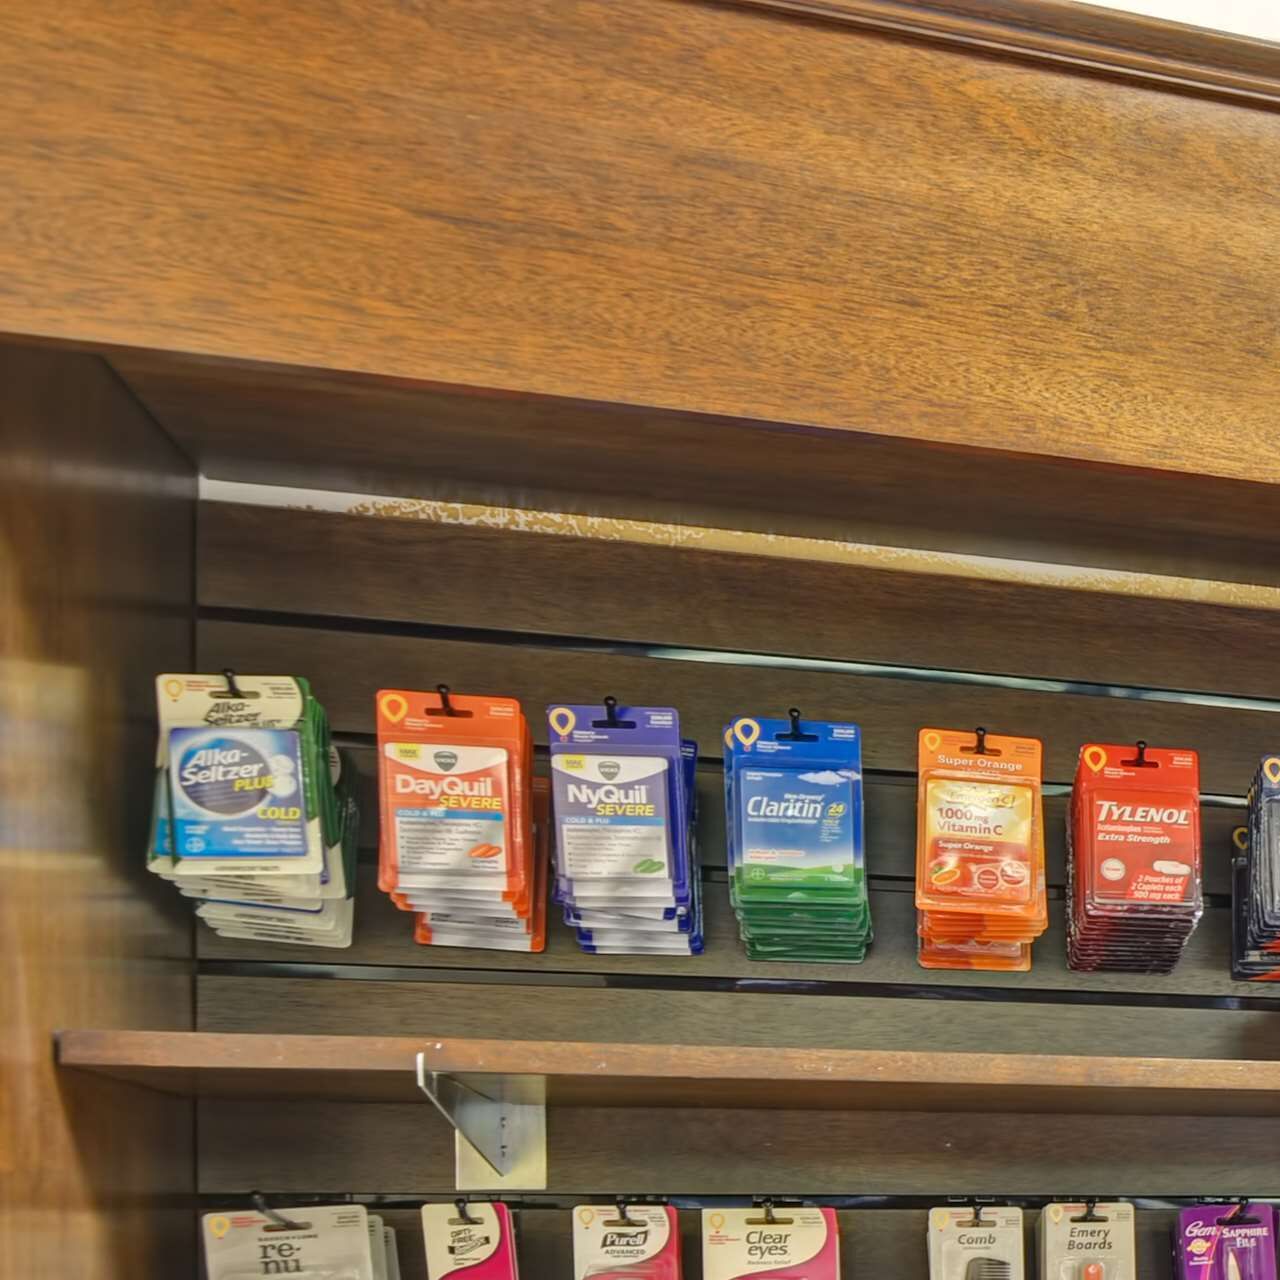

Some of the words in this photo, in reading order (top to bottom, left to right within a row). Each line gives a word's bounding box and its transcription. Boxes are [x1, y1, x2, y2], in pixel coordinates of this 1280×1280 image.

[186, 748, 249, 767] Alka-
[937, 754, 974, 768] Super
[977, 758, 1023, 772] Orange
[181, 762, 264, 786] Seltzer
[233, 775, 274, 792] PLUS
[395, 774, 492, 799] DayQuil
[439, 795, 503, 809] SEVERE
[567, 783, 648, 808] NyQuil
[256, 806, 300, 821] COLD
[596, 804, 655, 817] SEVERE
[747, 796, 822, 818] Claritin
[937, 807, 974, 823] 1000
[1096, 800, 1191, 825] TYLENOL
[937, 820, 992, 836] Vitamin
[993, 824, 1004, 837] C
[1097, 832, 1125, 843] Extra
[1126, 834, 1171, 845] Strength
[745, 1231, 791, 1245] Clear
[957, 1233, 996, 1246] Comb
[1069, 1227, 1111, 1243] Emery
[1221, 1226, 1269, 1238] SAPPHIRE
[747, 1244, 790, 1259] eyes
[1067, 1238, 1113, 1250] Boards
[262, 1257, 303, 1275] nu
